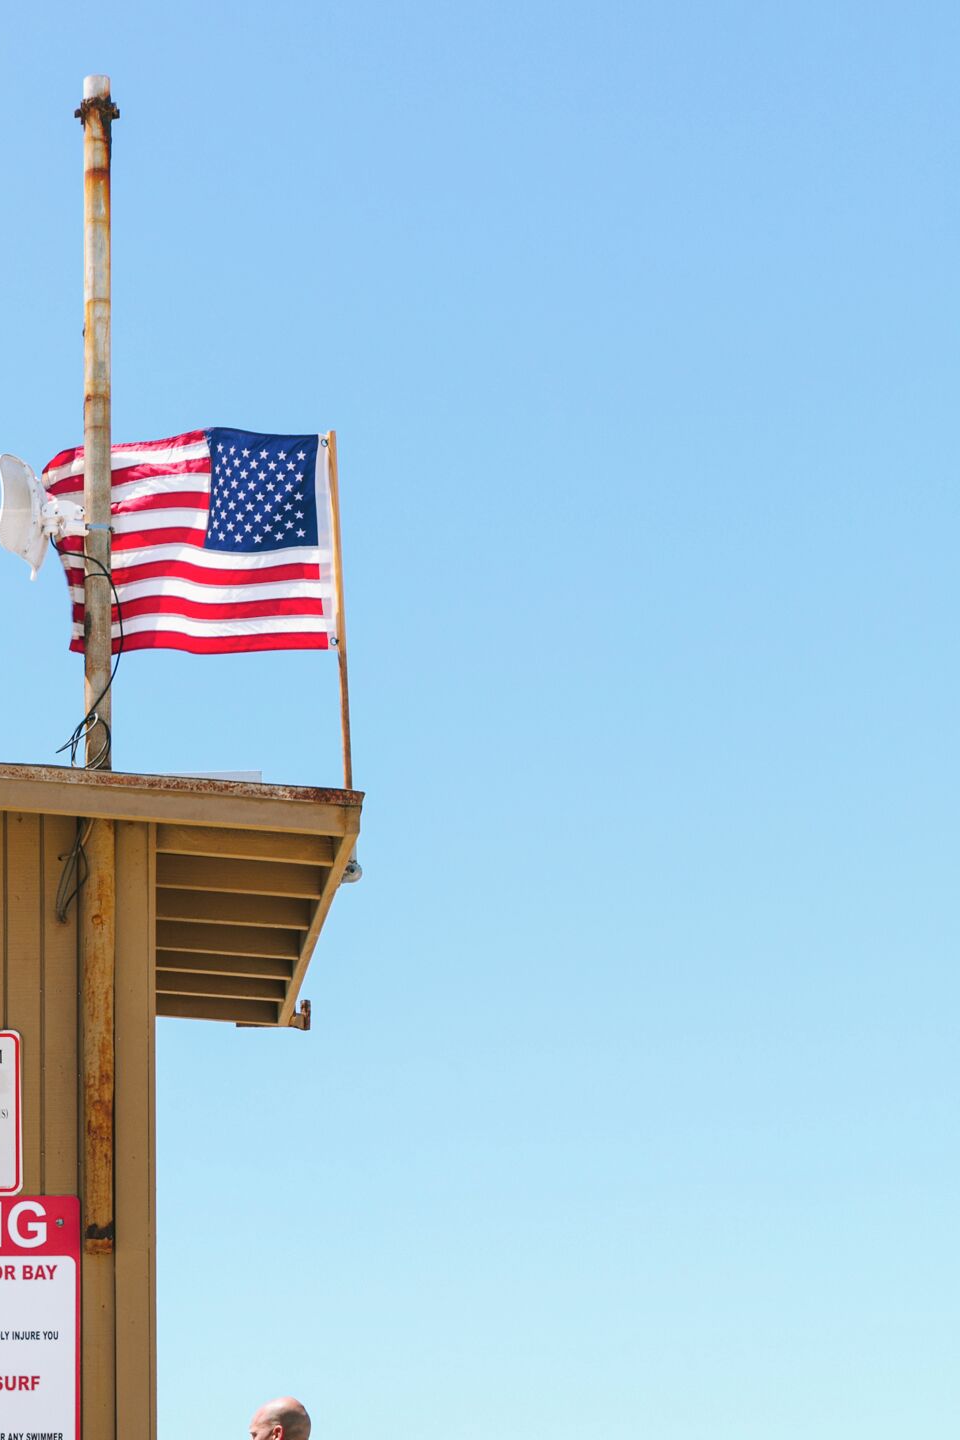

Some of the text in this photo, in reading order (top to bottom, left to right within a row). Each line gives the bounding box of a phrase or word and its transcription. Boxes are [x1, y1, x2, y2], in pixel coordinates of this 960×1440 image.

[22, 1265, 58, 1281] BAY
[12, 1331, 41, 1341] INJURE
[42, 1331, 59, 1341] YOU
